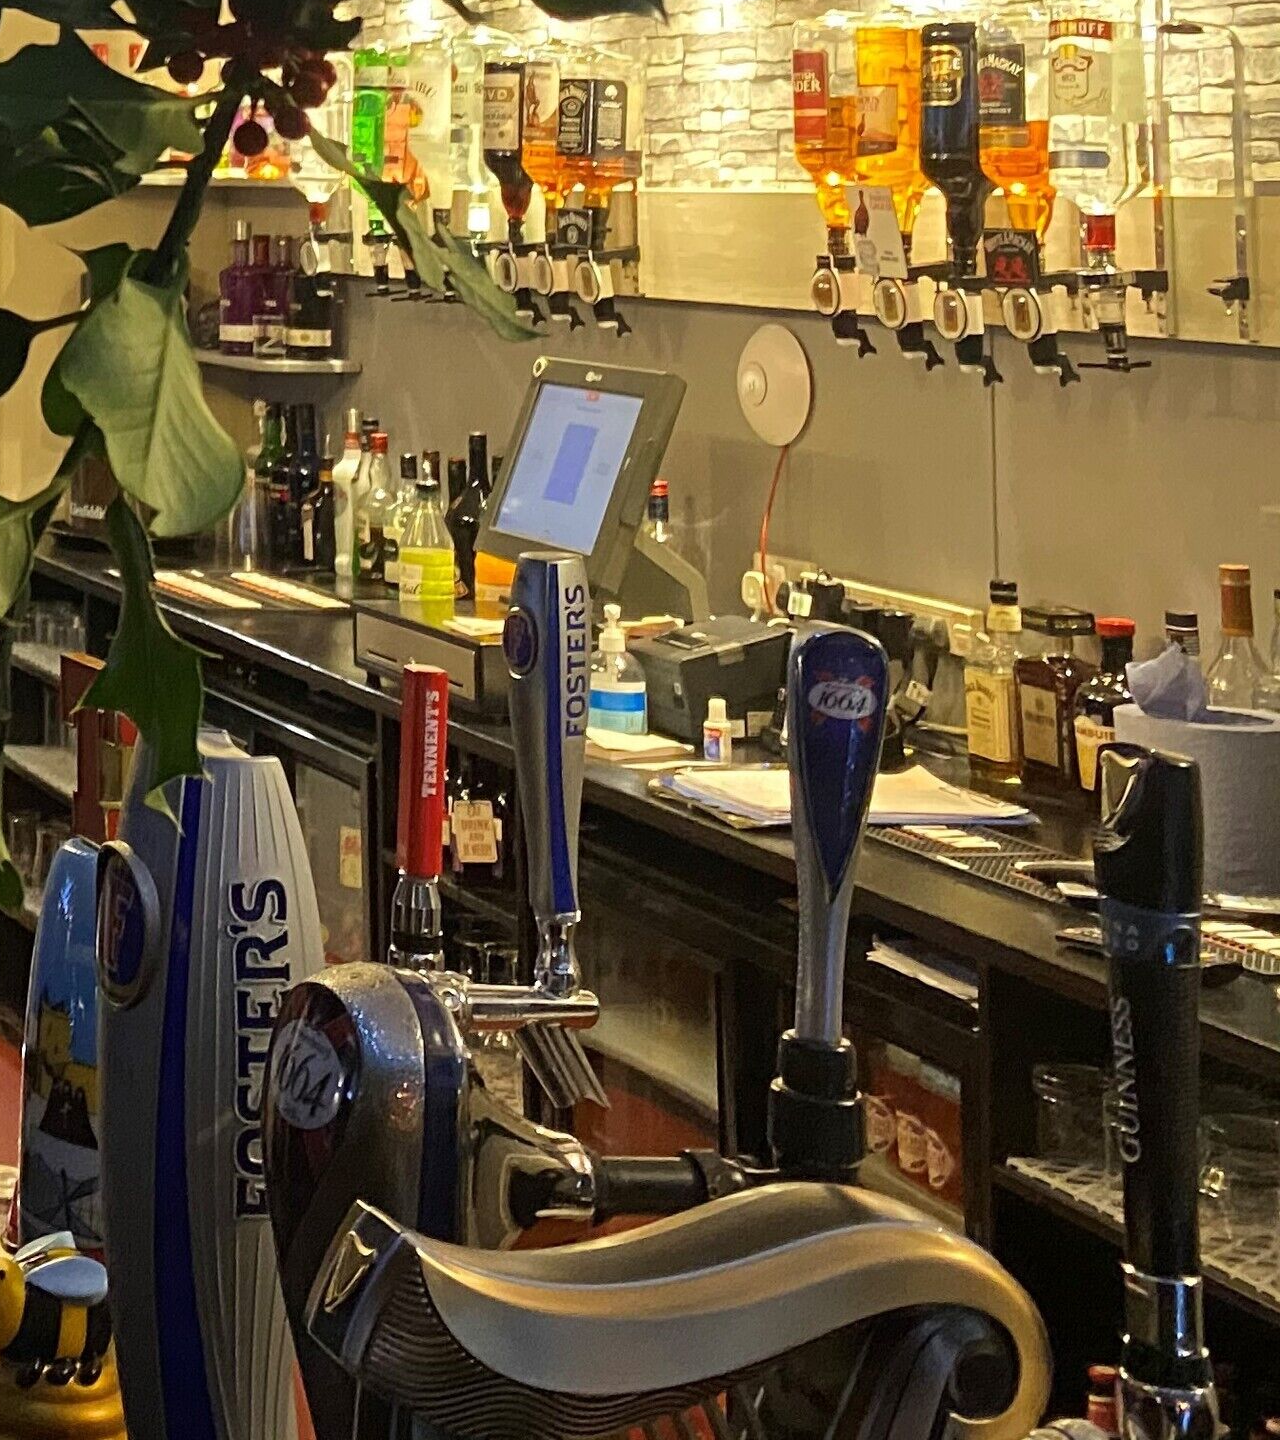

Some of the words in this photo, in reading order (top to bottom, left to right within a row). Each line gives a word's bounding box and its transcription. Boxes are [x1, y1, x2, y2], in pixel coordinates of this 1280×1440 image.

[565, 583, 586, 738] FOSTER'S
[816, 689, 868, 714] 1664
[421, 689, 440, 798] TENNENT'S
[227, 877, 292, 1220] FOSTER'S
[1110, 997, 1142, 1164] GUINNESS
